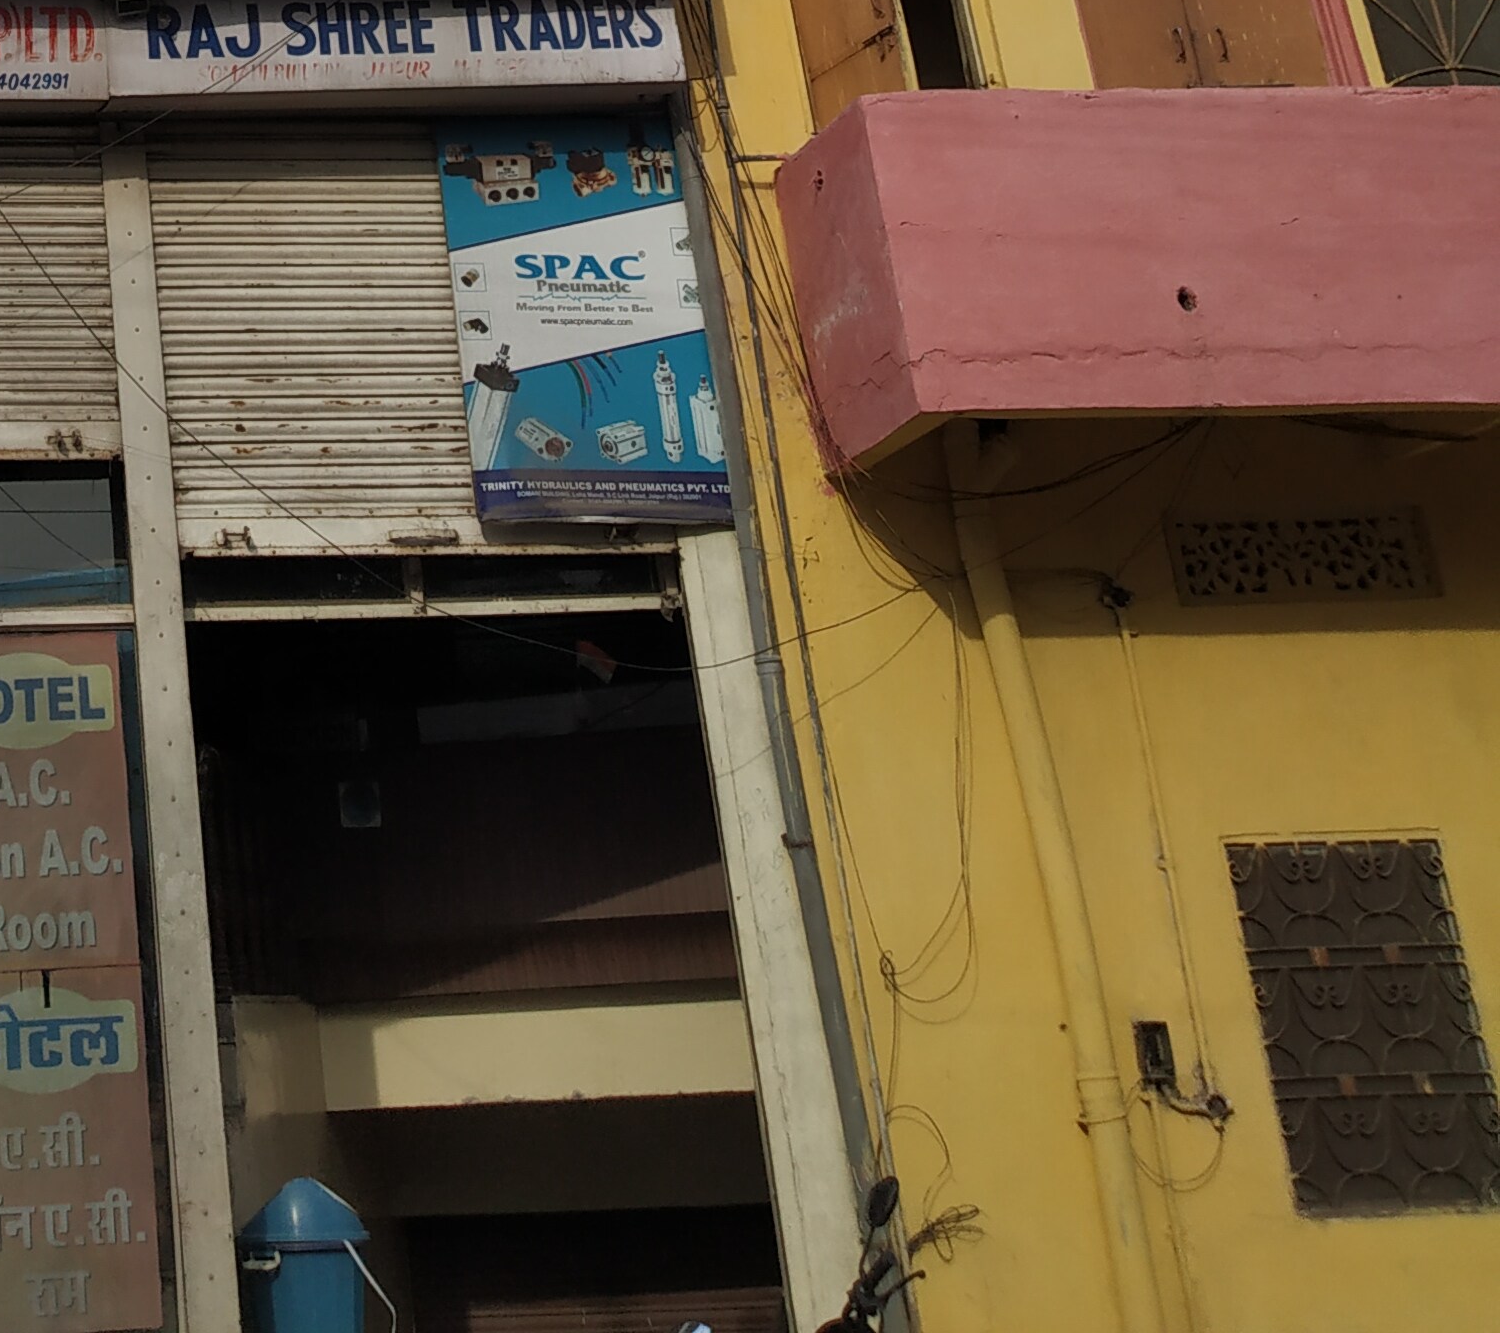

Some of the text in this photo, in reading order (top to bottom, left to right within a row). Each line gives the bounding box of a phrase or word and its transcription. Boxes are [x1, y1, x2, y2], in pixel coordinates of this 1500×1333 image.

[146, 1, 262, 60] RAJ
[280, 0, 436, 57] SHREE
[514, 253, 646, 281] SPAC
[536, 279, 632, 294] Pneumatic
[540, 317, 634, 326] www.spacpneumatic.com
[480, 480, 525, 492] TRINITY
[526, 480, 592, 491] HYDRAULICS
[594, 481, 617, 491] AND
[619, 482, 685, 493] PNEUMATICS
[687, 483, 710, 493] PVT.
[39, 826, 124, 877] A.C.
